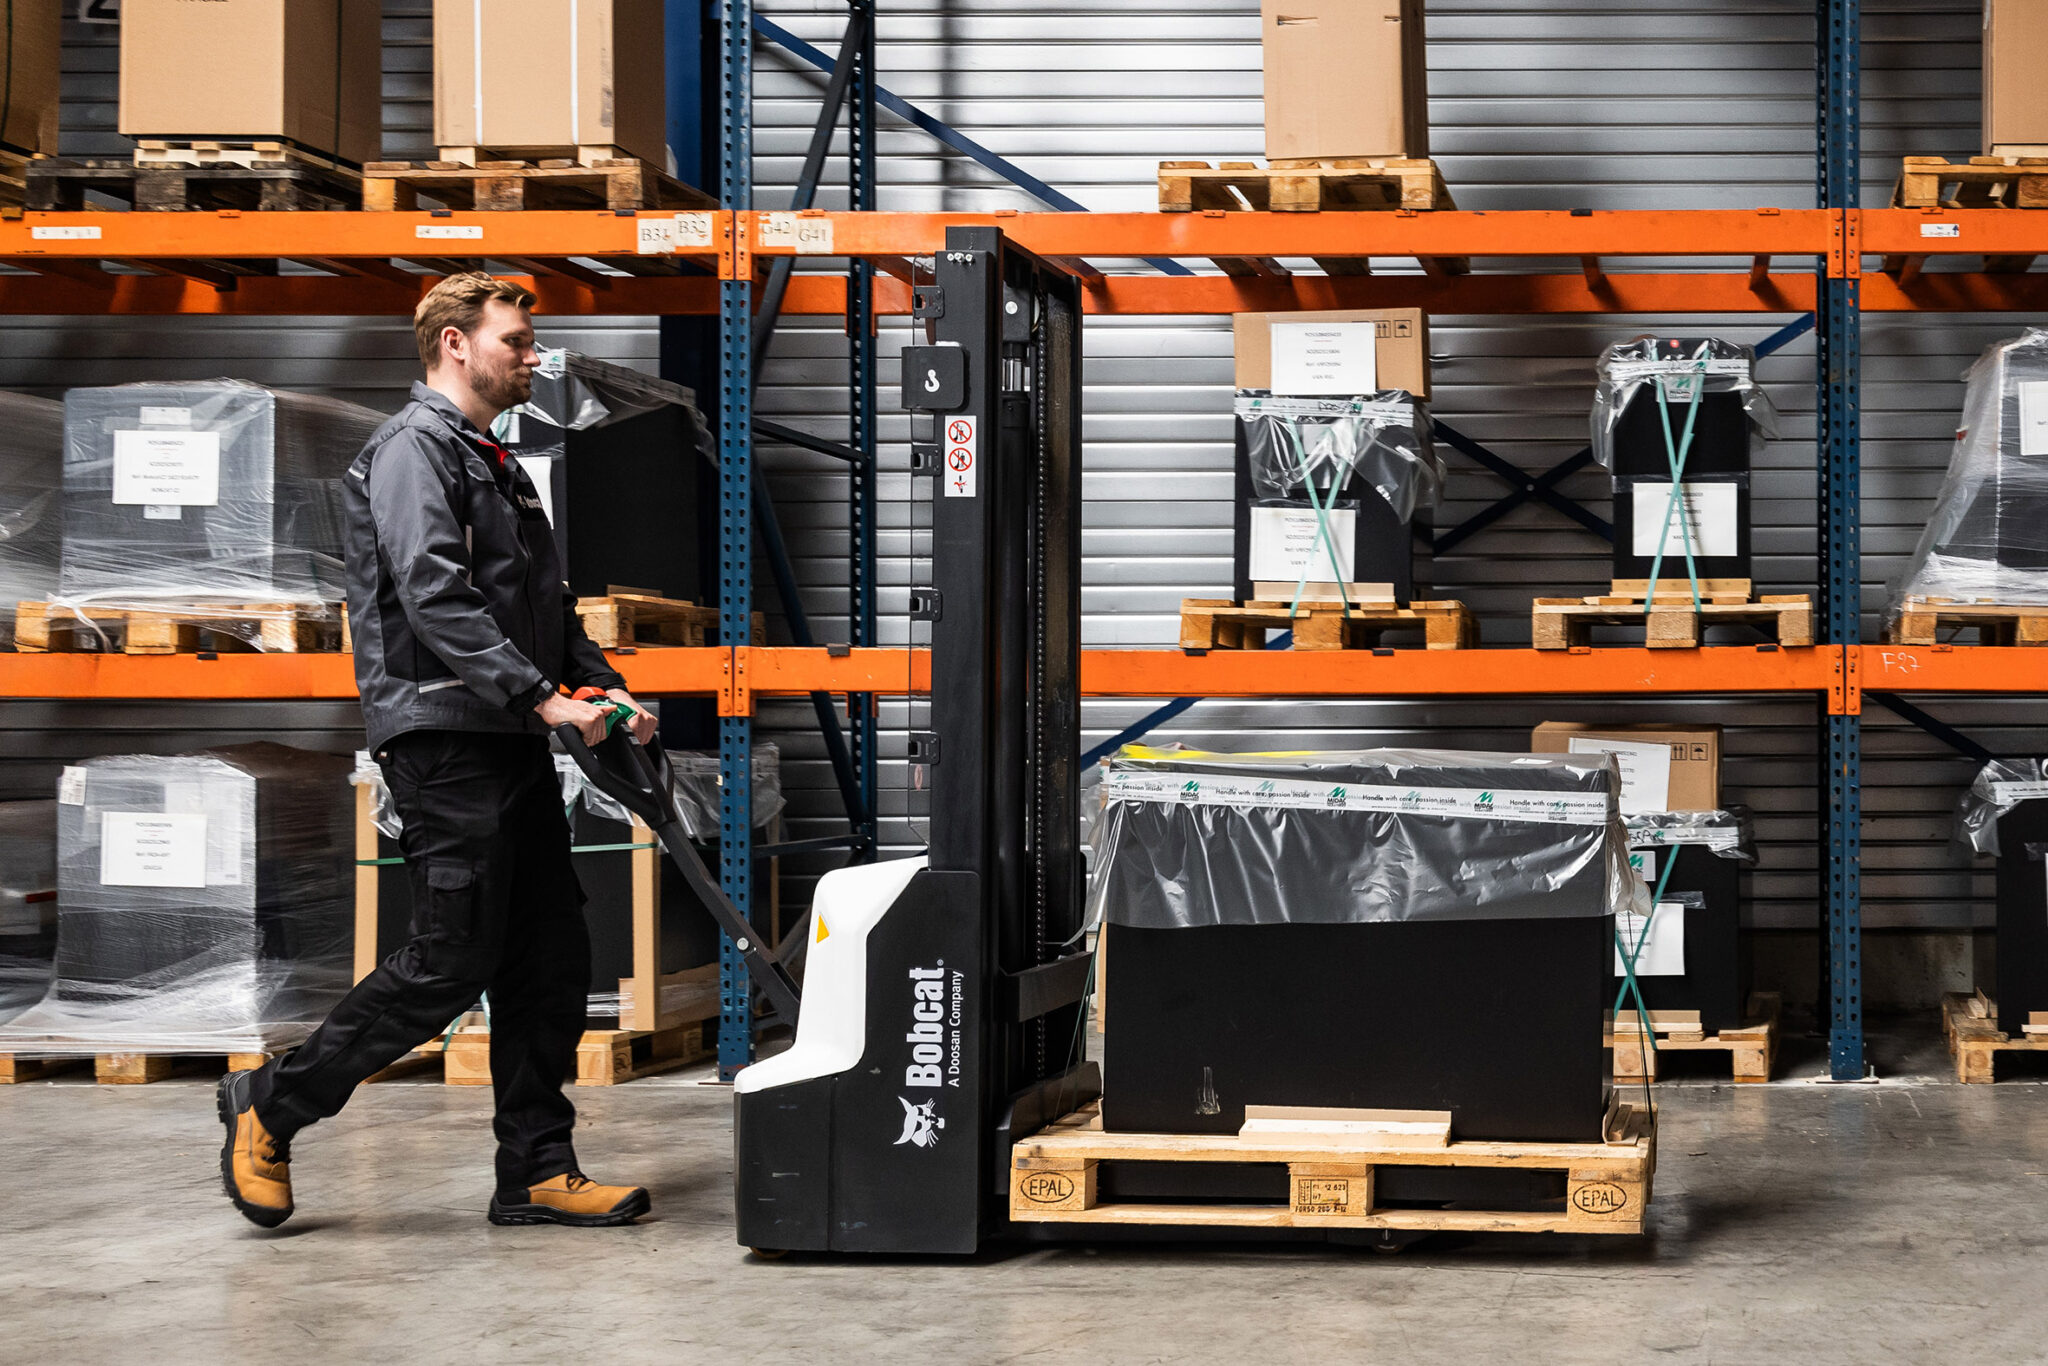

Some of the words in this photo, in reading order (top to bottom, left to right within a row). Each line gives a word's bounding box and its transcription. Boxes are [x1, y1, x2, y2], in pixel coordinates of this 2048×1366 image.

[678, 220, 707, 235] B32
[762, 220, 790, 235] G42
[798, 228, 827, 242] G41
[1215, 788, 1237, 796] Handle
[1268, 791, 1291, 799] passion
[1509, 799, 1531, 807] Handle
[1563, 801, 1586, 809] passion
[948, 970, 964, 1027] Company
[948, 1029, 961, 1073] Doosan
[948, 1077, 960, 1088] A
[1029, 1178, 1067, 1197] EPAL
[1581, 1189, 1620, 1207] EPAL
